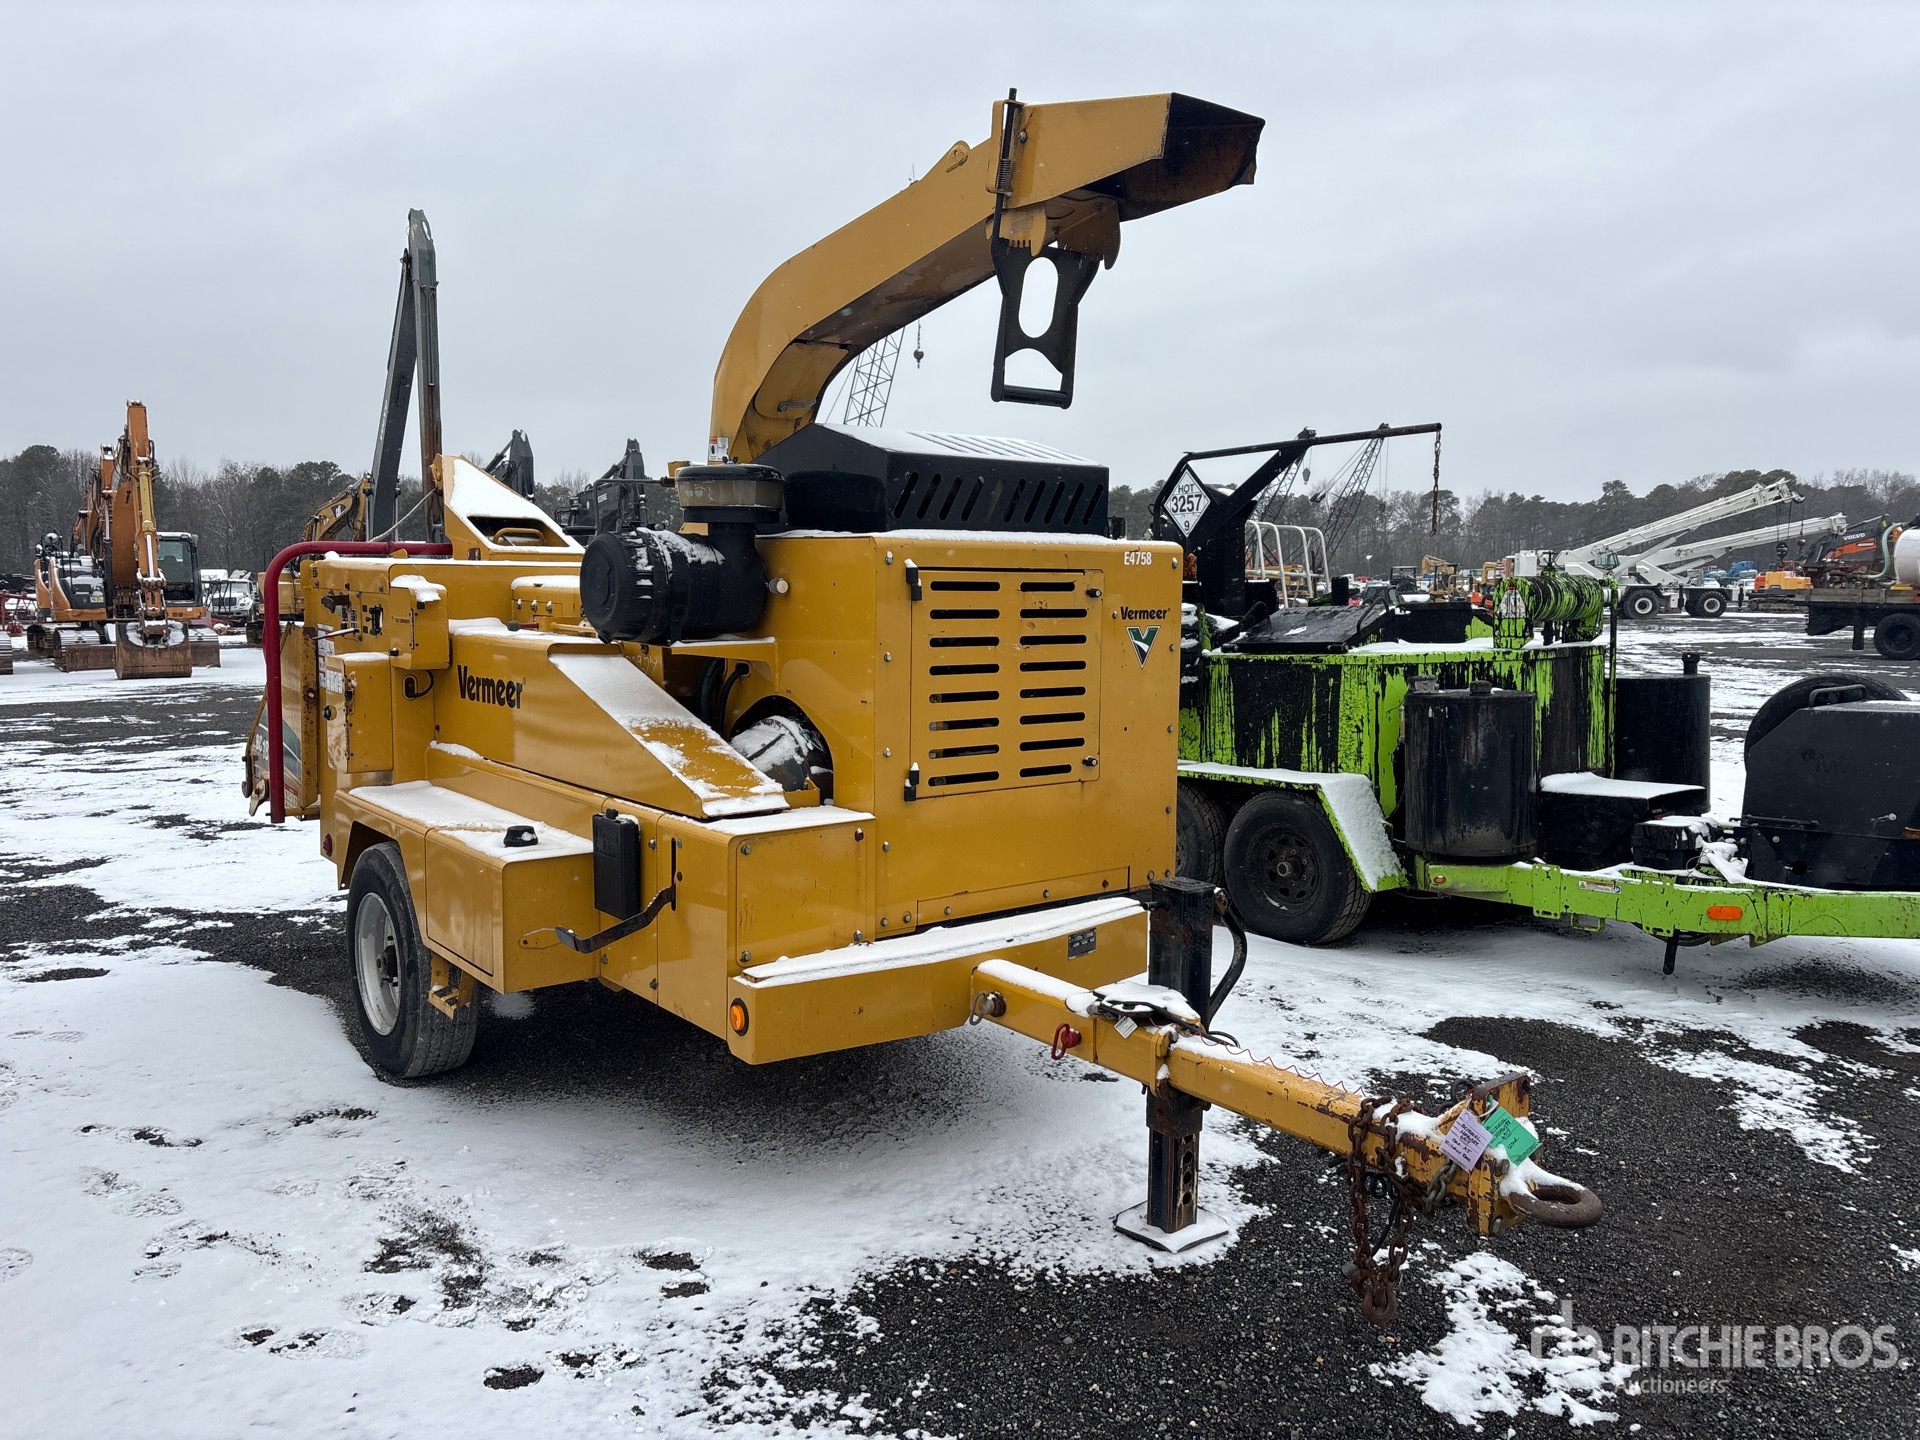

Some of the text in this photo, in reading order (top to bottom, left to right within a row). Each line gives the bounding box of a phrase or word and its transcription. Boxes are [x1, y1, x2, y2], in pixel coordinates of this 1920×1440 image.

[1178, 484, 1195, 494] HOT
[1171, 494, 1202, 513] 3257
[1184, 520, 1190, 531] 9
[1124, 551, 1152, 566] E4758
[1120, 606, 1168, 620] Vermeer
[457, 664, 524, 709] Vermeer
